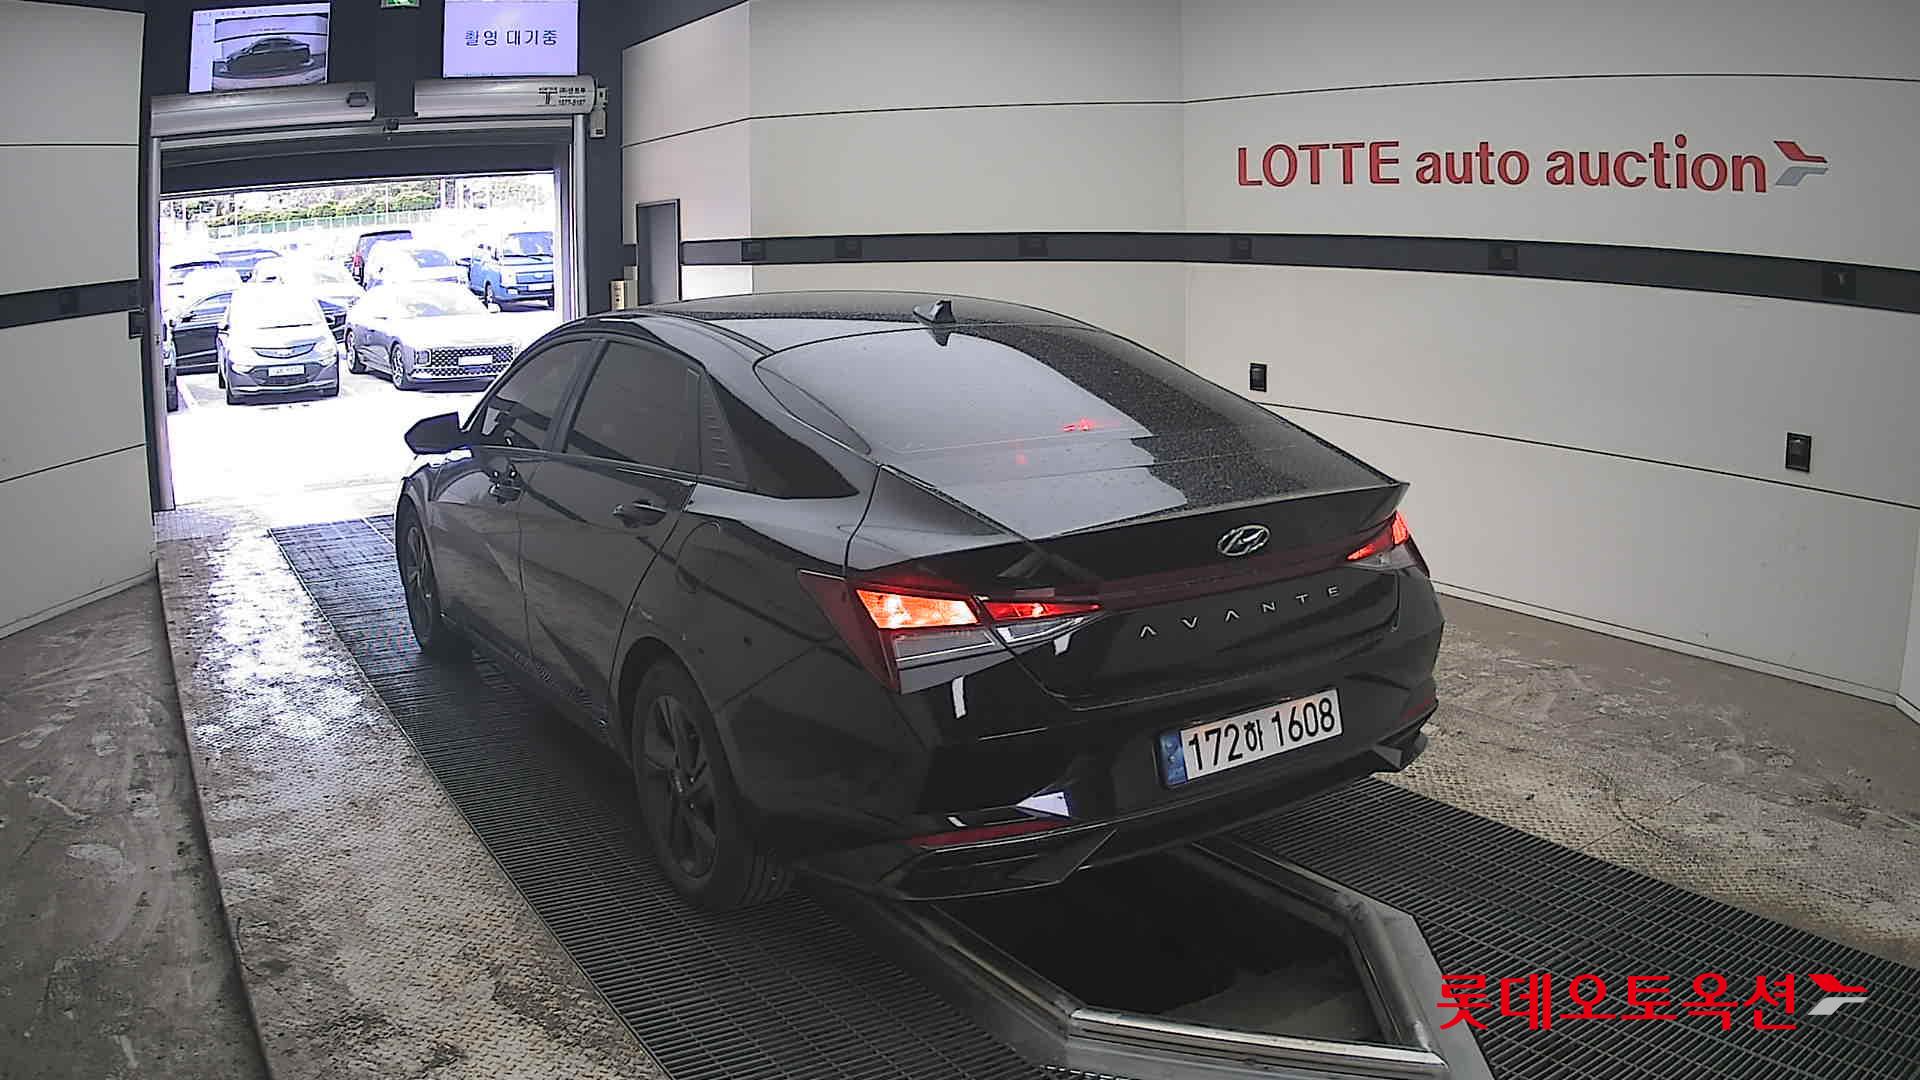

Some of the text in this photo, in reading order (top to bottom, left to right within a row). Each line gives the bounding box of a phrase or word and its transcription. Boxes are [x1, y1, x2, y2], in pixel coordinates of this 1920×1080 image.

[506, 29, 557, 46] 대기중
[1238, 134, 1767, 193] LOTTE auto auction
[1139, 585, 1341, 638] AVANTE
[1188, 697, 1335, 771] 172하 1608
